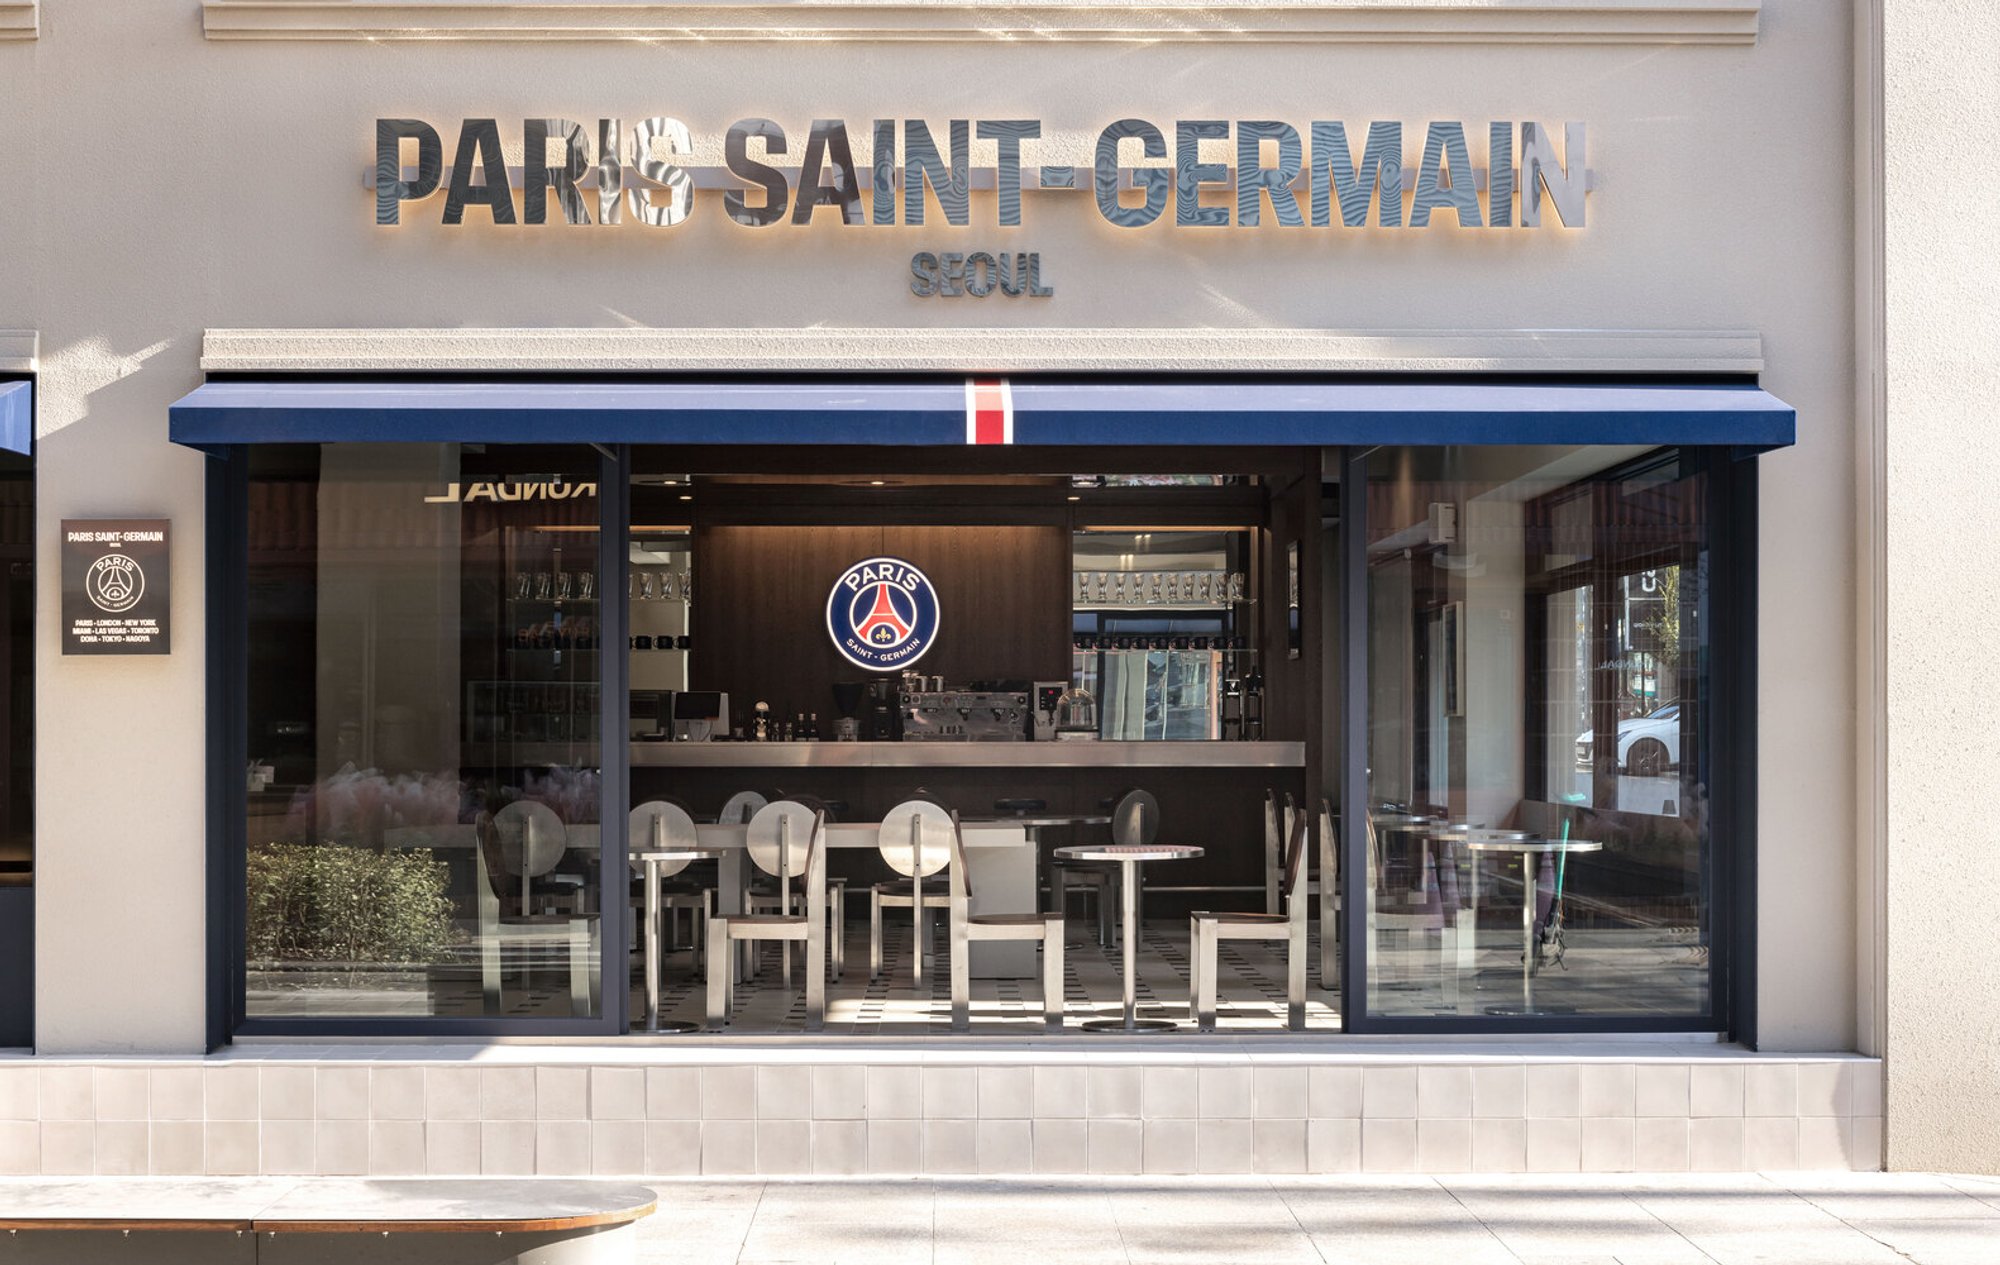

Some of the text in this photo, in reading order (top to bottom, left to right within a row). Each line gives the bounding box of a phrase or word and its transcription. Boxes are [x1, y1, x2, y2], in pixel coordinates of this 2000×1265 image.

[376, 117, 1586, 228] PARIS SAINT-GERMAIN
[911, 251, 1054, 298] SEOUL
[68, 531, 94, 542] PARIS
[96, 557, 135, 572] PARIS
[845, 564, 920, 592] PARIS
[75, 619, 93, 627] PARIS
[125, 619, 138, 627] NEW
[139, 619, 156, 627] YORK
[95, 627, 107, 635] LAS
[102, 635, 122, 643] TOKYO
